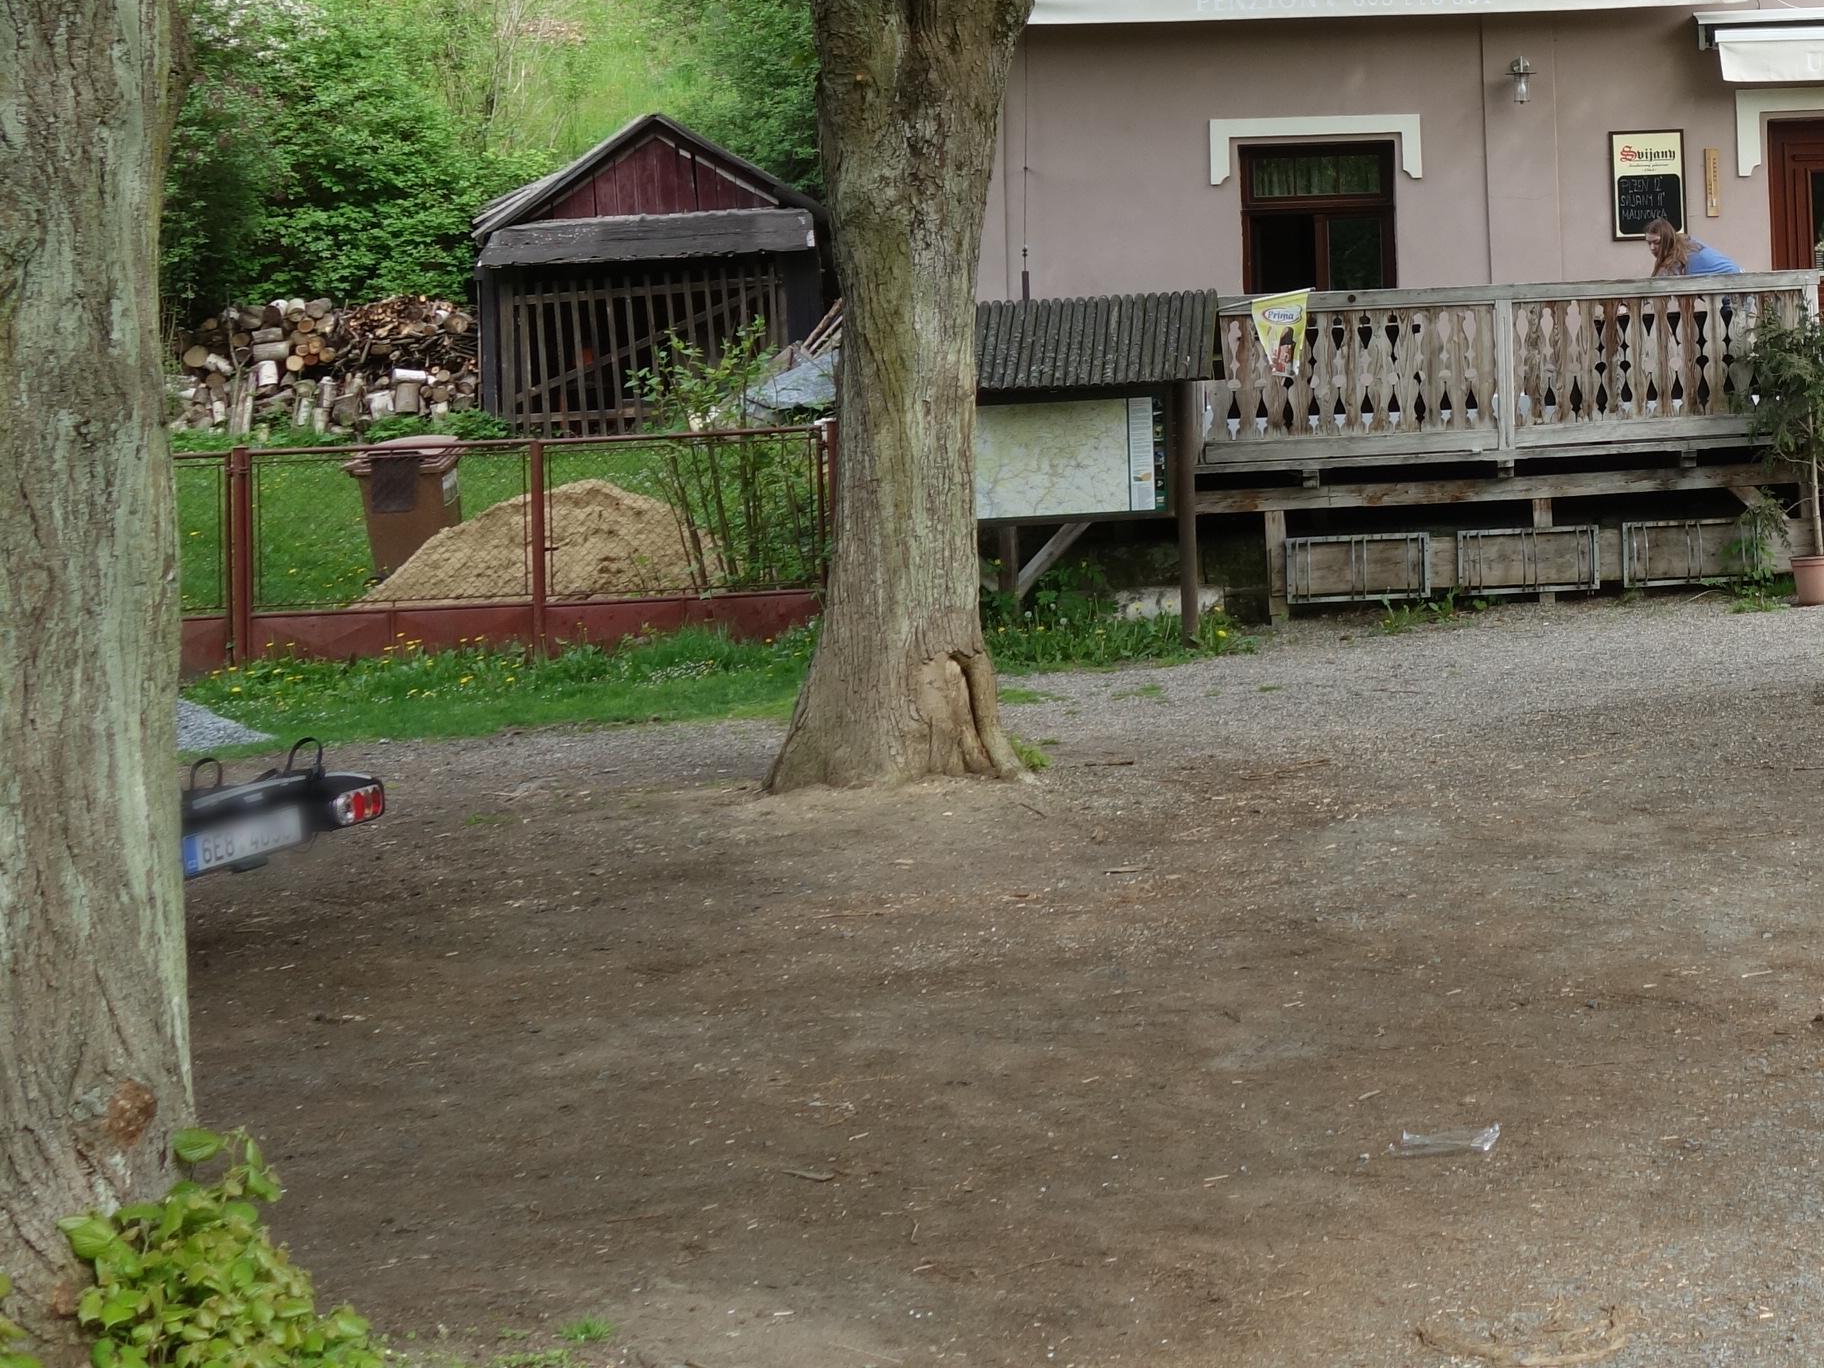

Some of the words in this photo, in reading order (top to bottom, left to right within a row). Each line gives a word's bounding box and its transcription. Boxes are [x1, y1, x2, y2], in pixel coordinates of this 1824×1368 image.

[1807, 52, 1822, 72] U
[1620, 145, 1676, 162] Svijany
[1267, 311, 1295, 321] Prima
